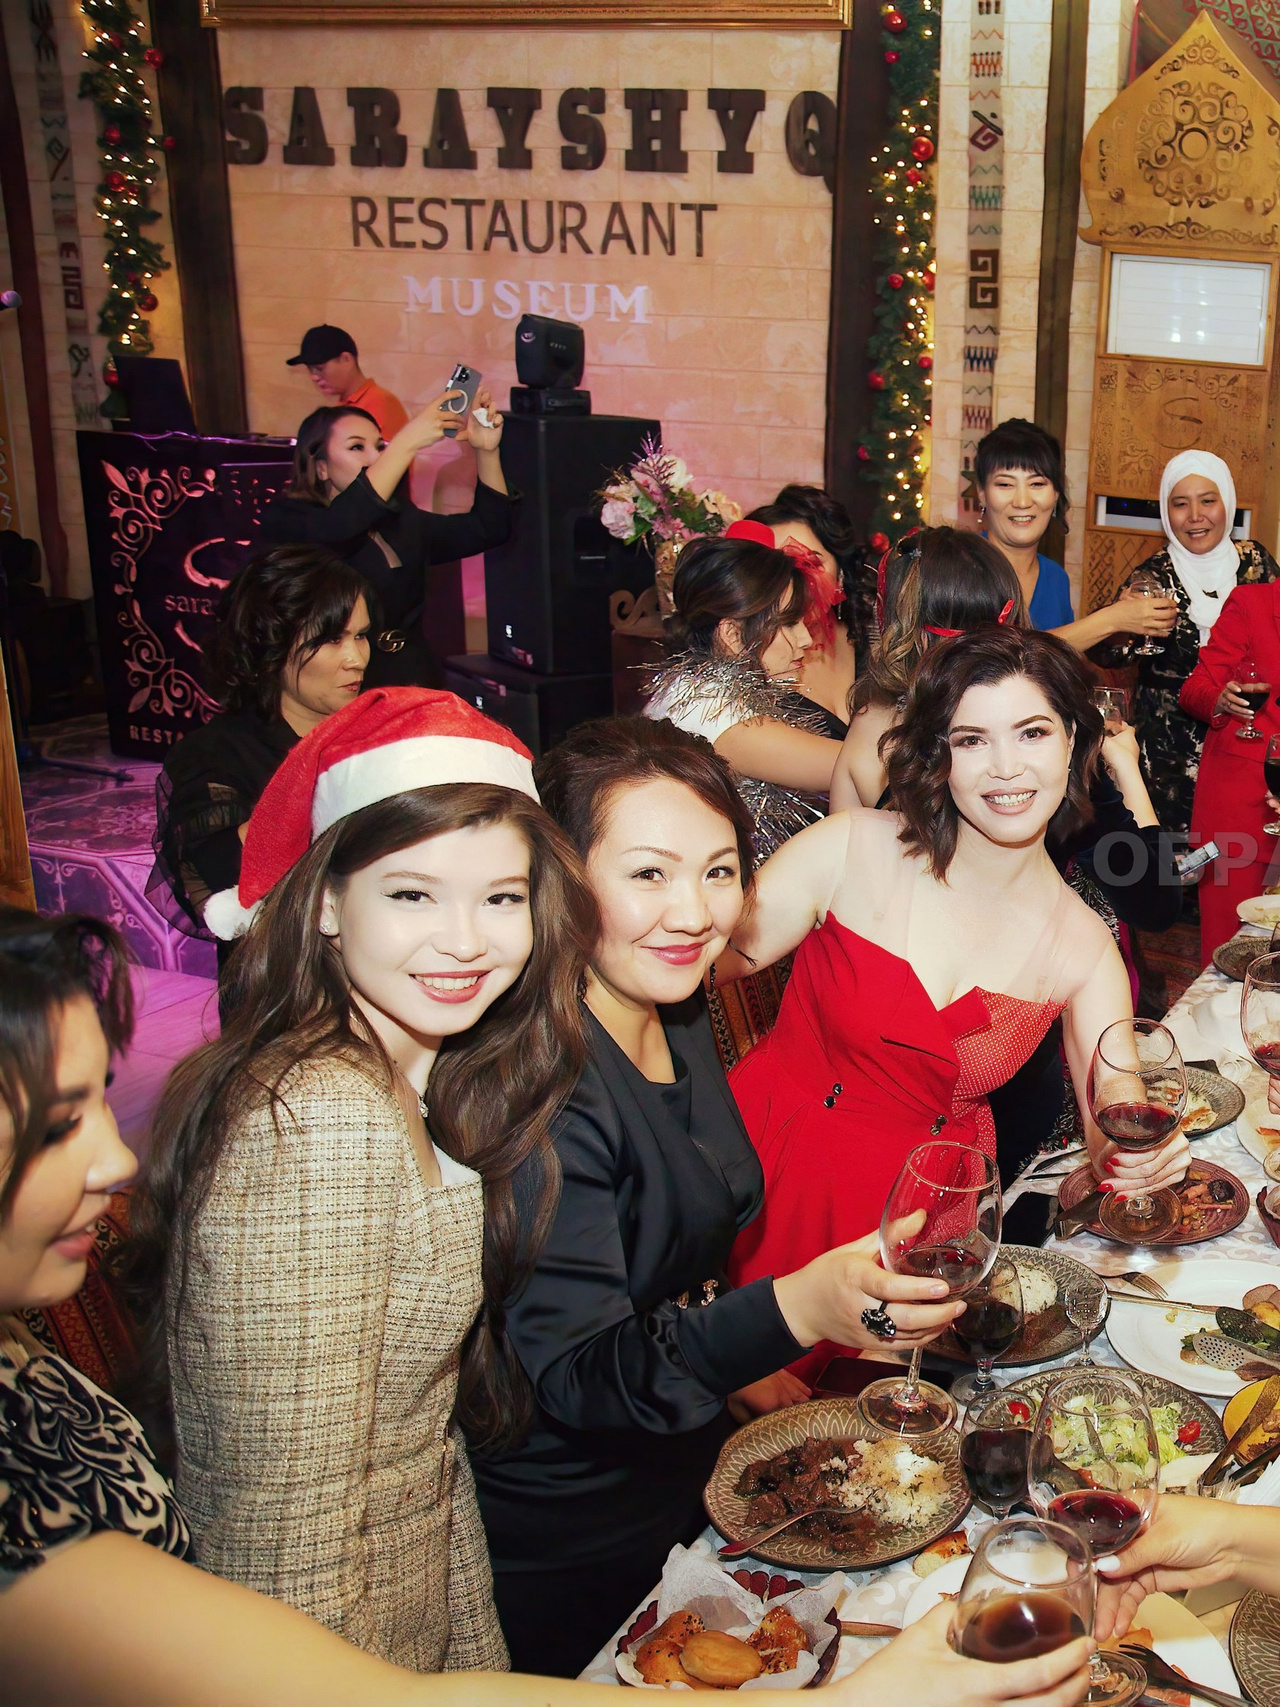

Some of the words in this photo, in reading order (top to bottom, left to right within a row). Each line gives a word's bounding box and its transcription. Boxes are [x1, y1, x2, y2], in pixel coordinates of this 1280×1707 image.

[224, 86, 838, 194] SARAYSHYQ
[351, 196, 718, 257] RESTAURANT
[403, 275, 653, 324] MUSEUM
[164, 594, 217, 616] sara
